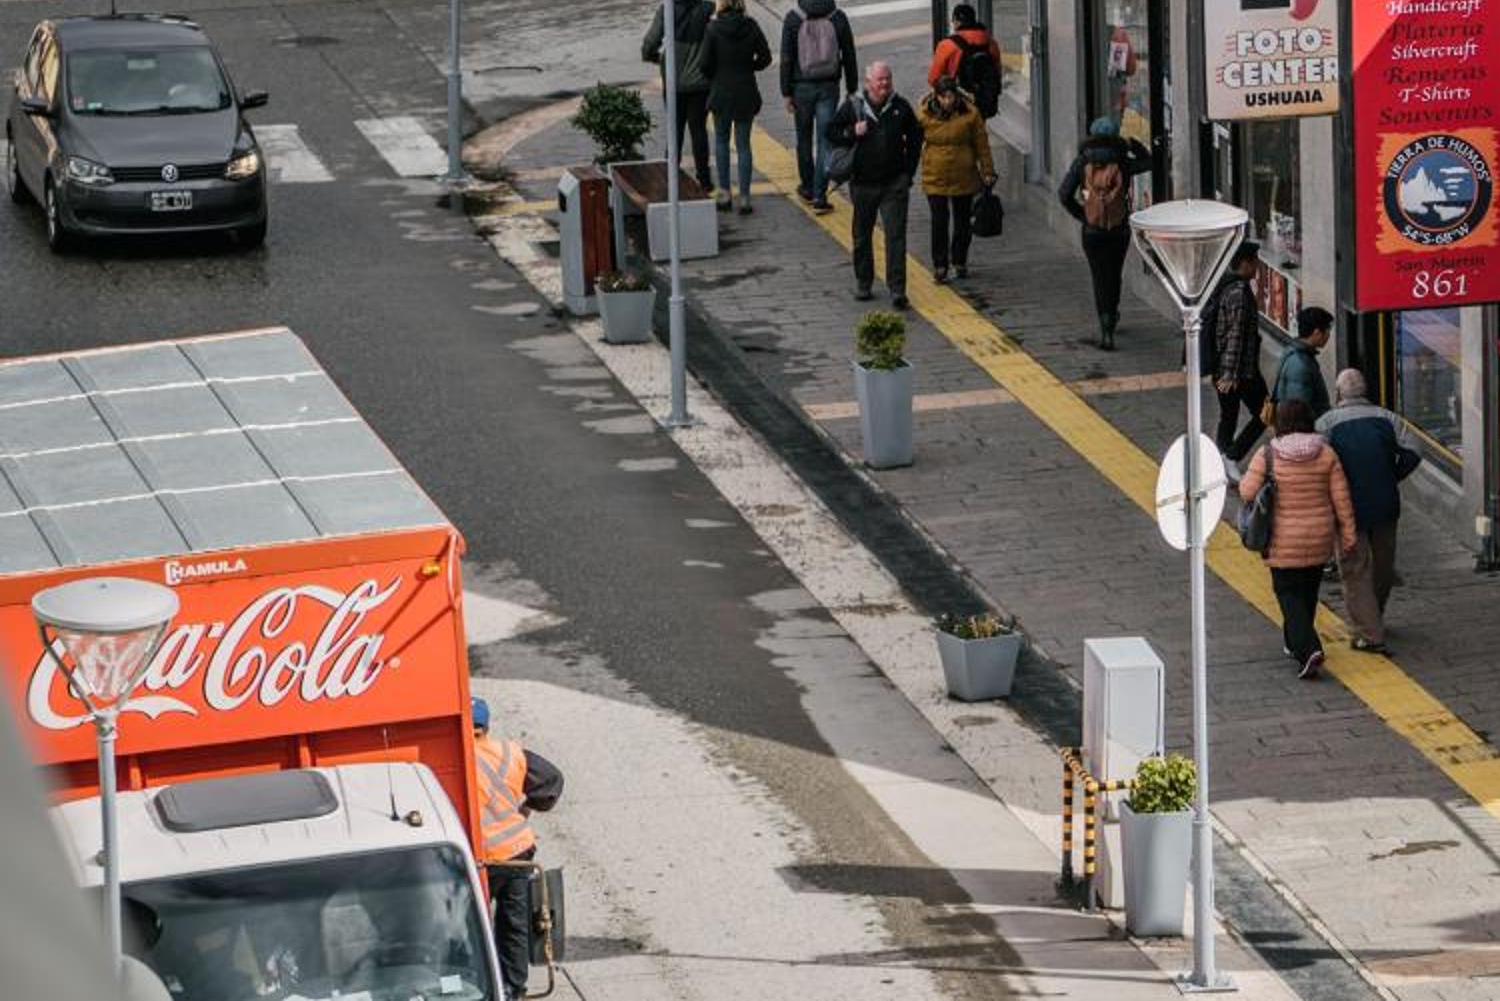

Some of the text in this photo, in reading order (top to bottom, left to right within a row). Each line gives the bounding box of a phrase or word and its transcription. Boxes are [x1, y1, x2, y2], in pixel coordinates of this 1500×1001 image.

[1236, 27, 1324, 57] FOTO
[1391, 39, 1479, 63] Silvercraft
[1222, 55, 1340, 89] CENTER
[1244, 88, 1323, 107] USHUAIA
[1398, 81, 1472, 103] T-Shirts
[1379, 101, 1493, 125] Souvenirs
[1387, 136, 1489, 180] TIERRA DE HUMOS
[1412, 268, 1468, 298] 861
[27, 574, 402, 730] Ca-Cola
